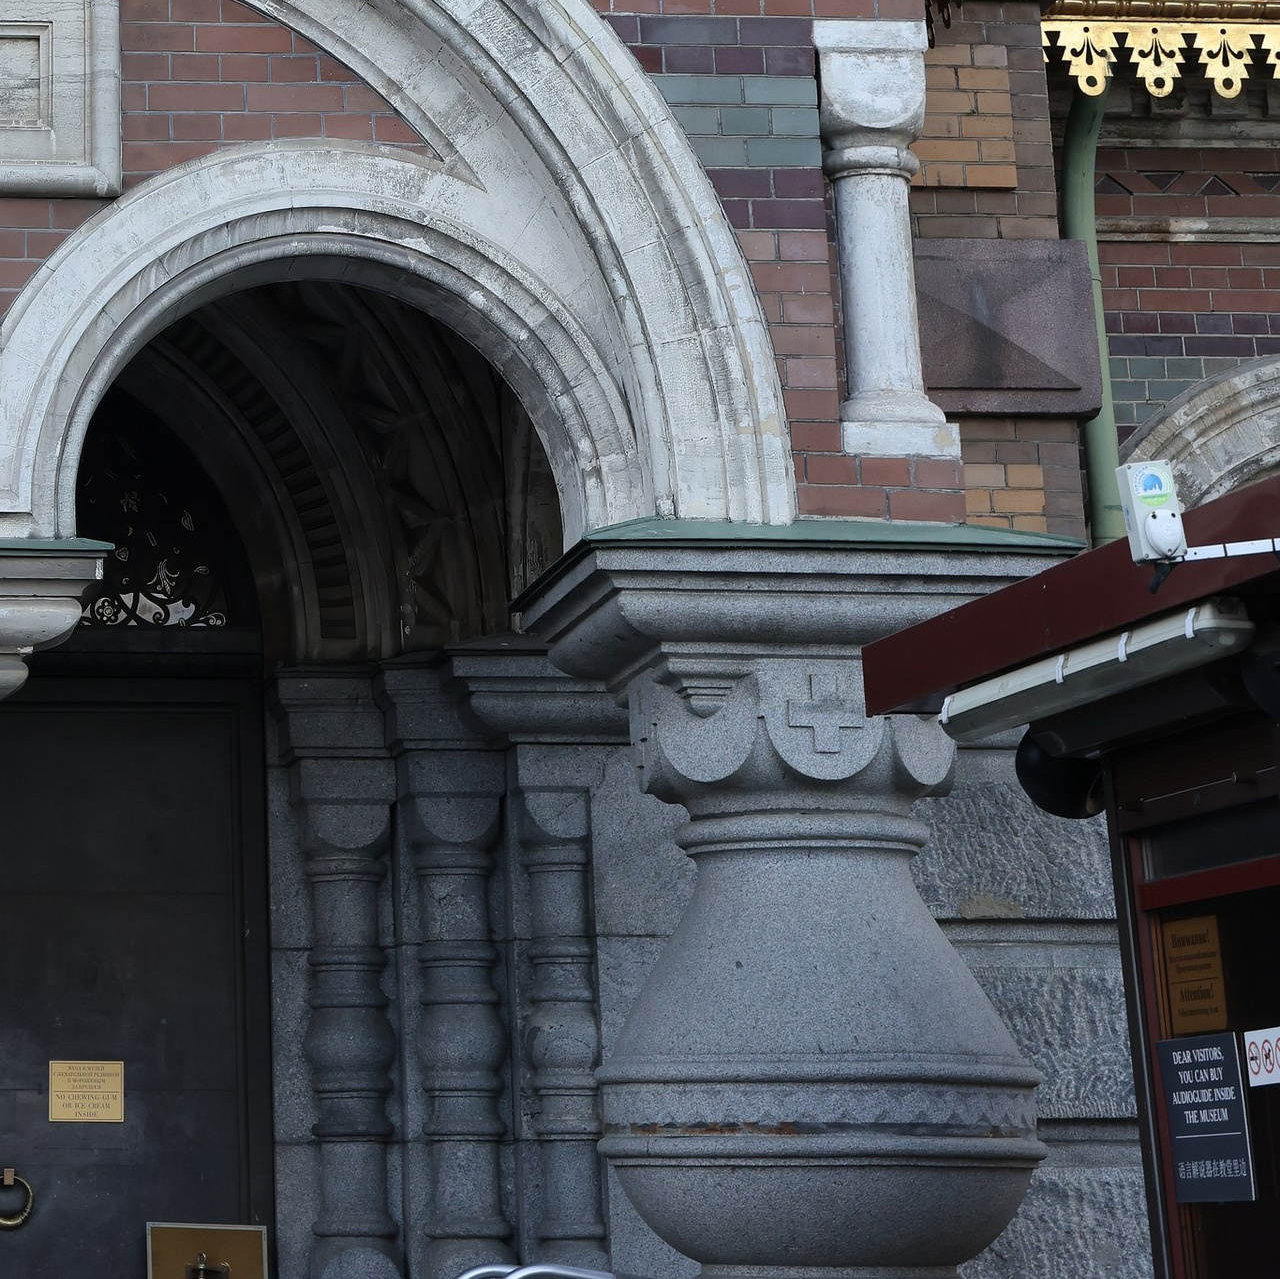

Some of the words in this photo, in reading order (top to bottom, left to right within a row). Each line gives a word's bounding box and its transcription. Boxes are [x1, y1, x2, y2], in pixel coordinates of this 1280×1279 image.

[1171, 927, 1210, 948] Внимание!
[1180, 982, 1214, 1002] Attention!
[1172, 1050, 1193, 1065] DEAR
[1192, 1047, 1224, 1062] VISITORS,
[1178, 1070, 1194, 1084] YOU
[1194, 1069, 1209, 1082] CAN
[1210, 1067, 1224, 1081] BUY
[1172, 1090, 1213, 1105] AUDIOGUIDE
[1214, 1086, 1236, 1101] INSIDE
[1184, 1110, 1199, 1124] THE
[1200, 1108, 1229, 1122] MUSEUM
